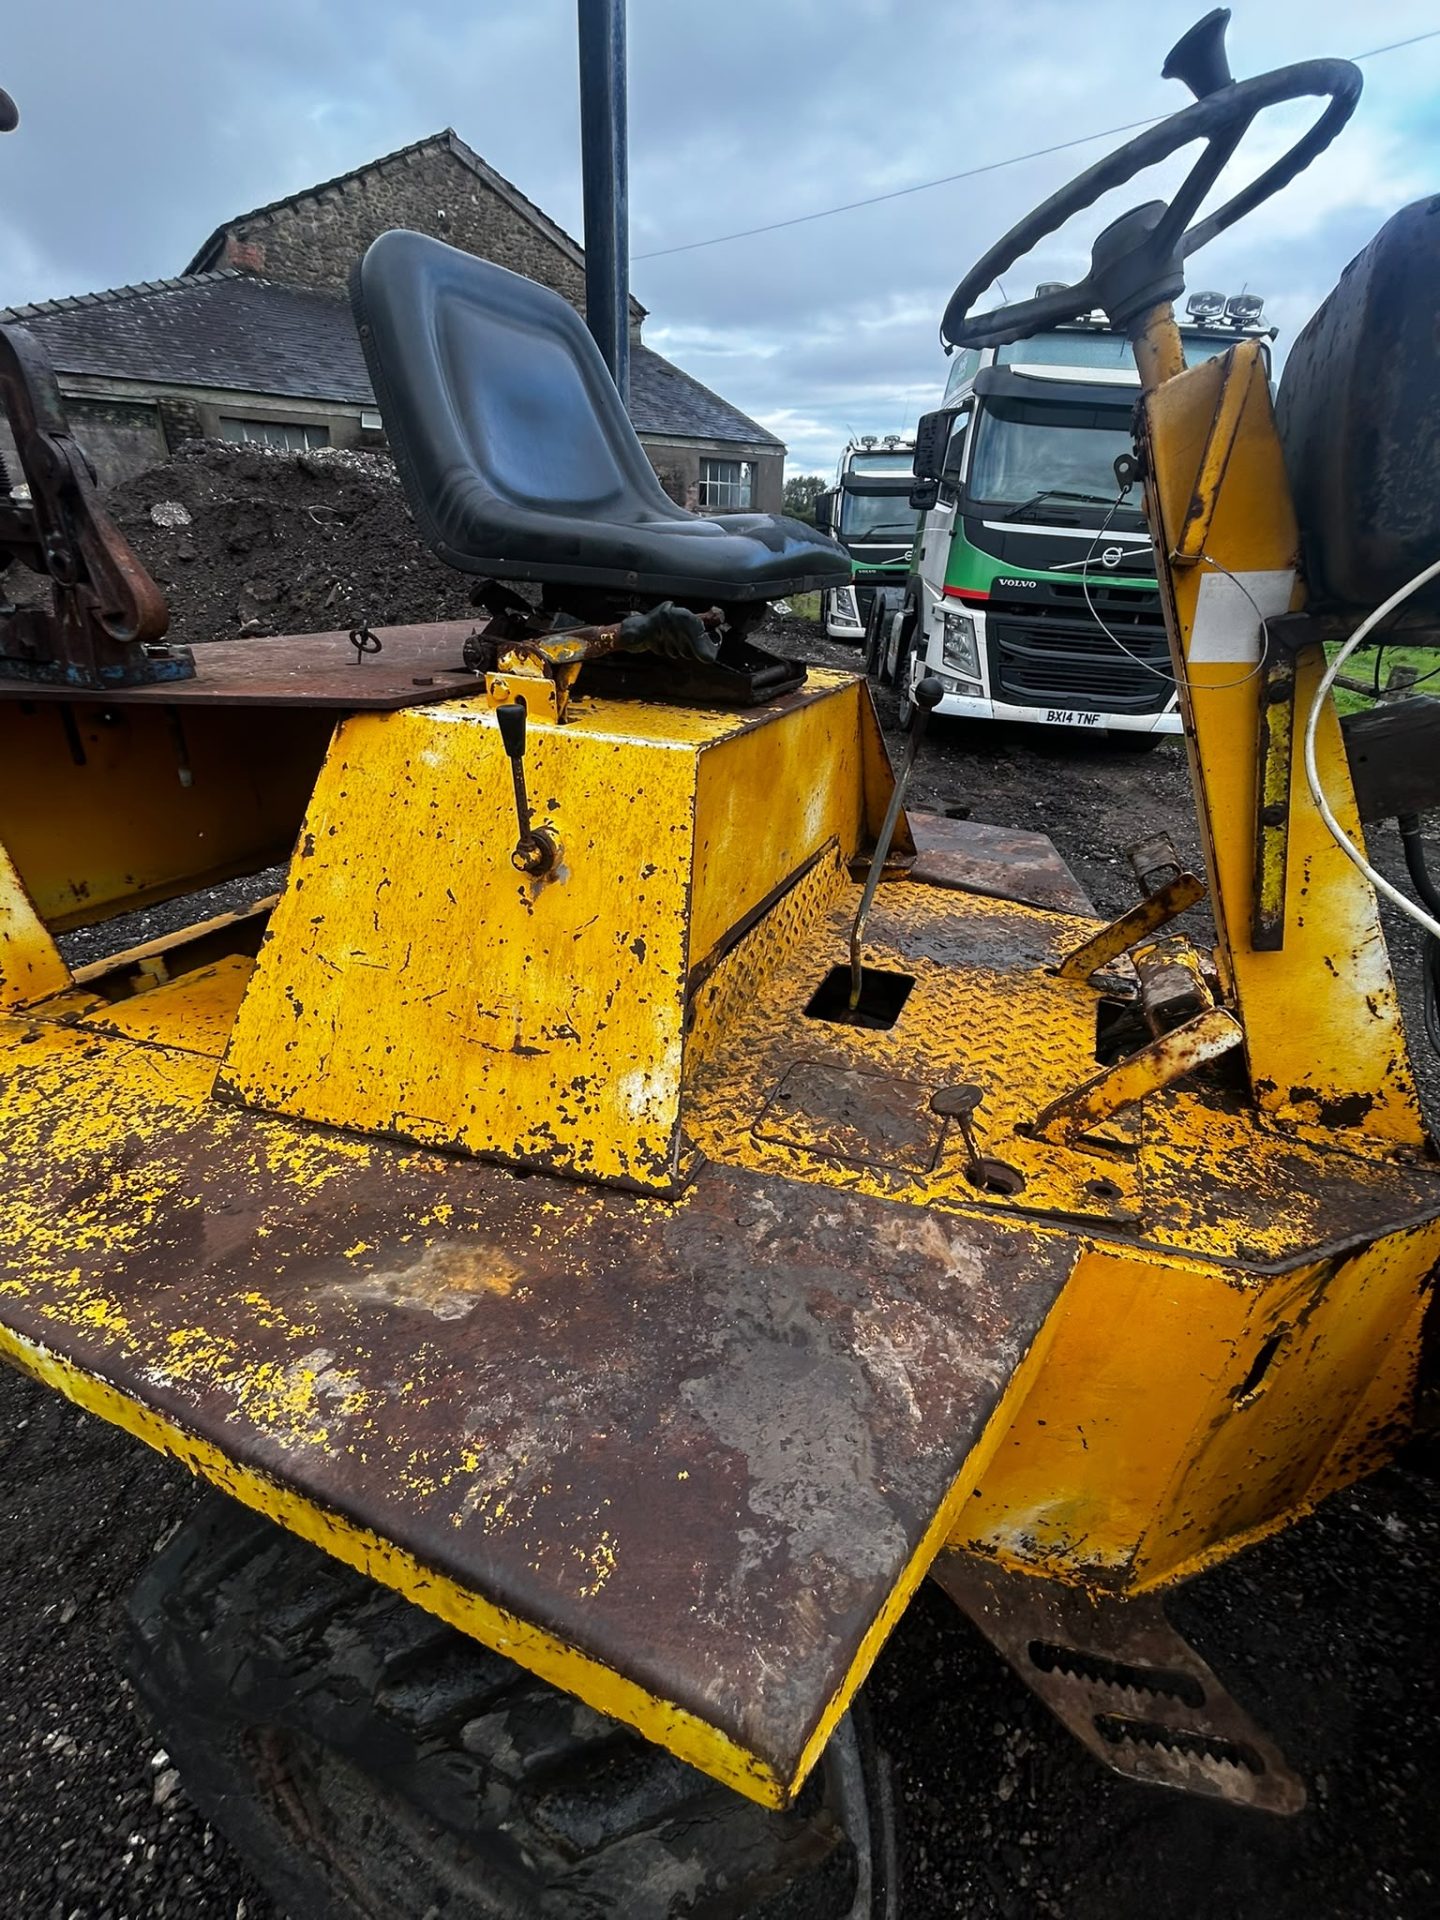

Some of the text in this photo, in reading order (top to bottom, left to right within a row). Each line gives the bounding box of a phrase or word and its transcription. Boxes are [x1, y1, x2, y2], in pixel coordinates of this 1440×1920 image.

[999, 579, 1036, 588] VOLVO
[1046, 710, 1100, 725] BX14 TNF
